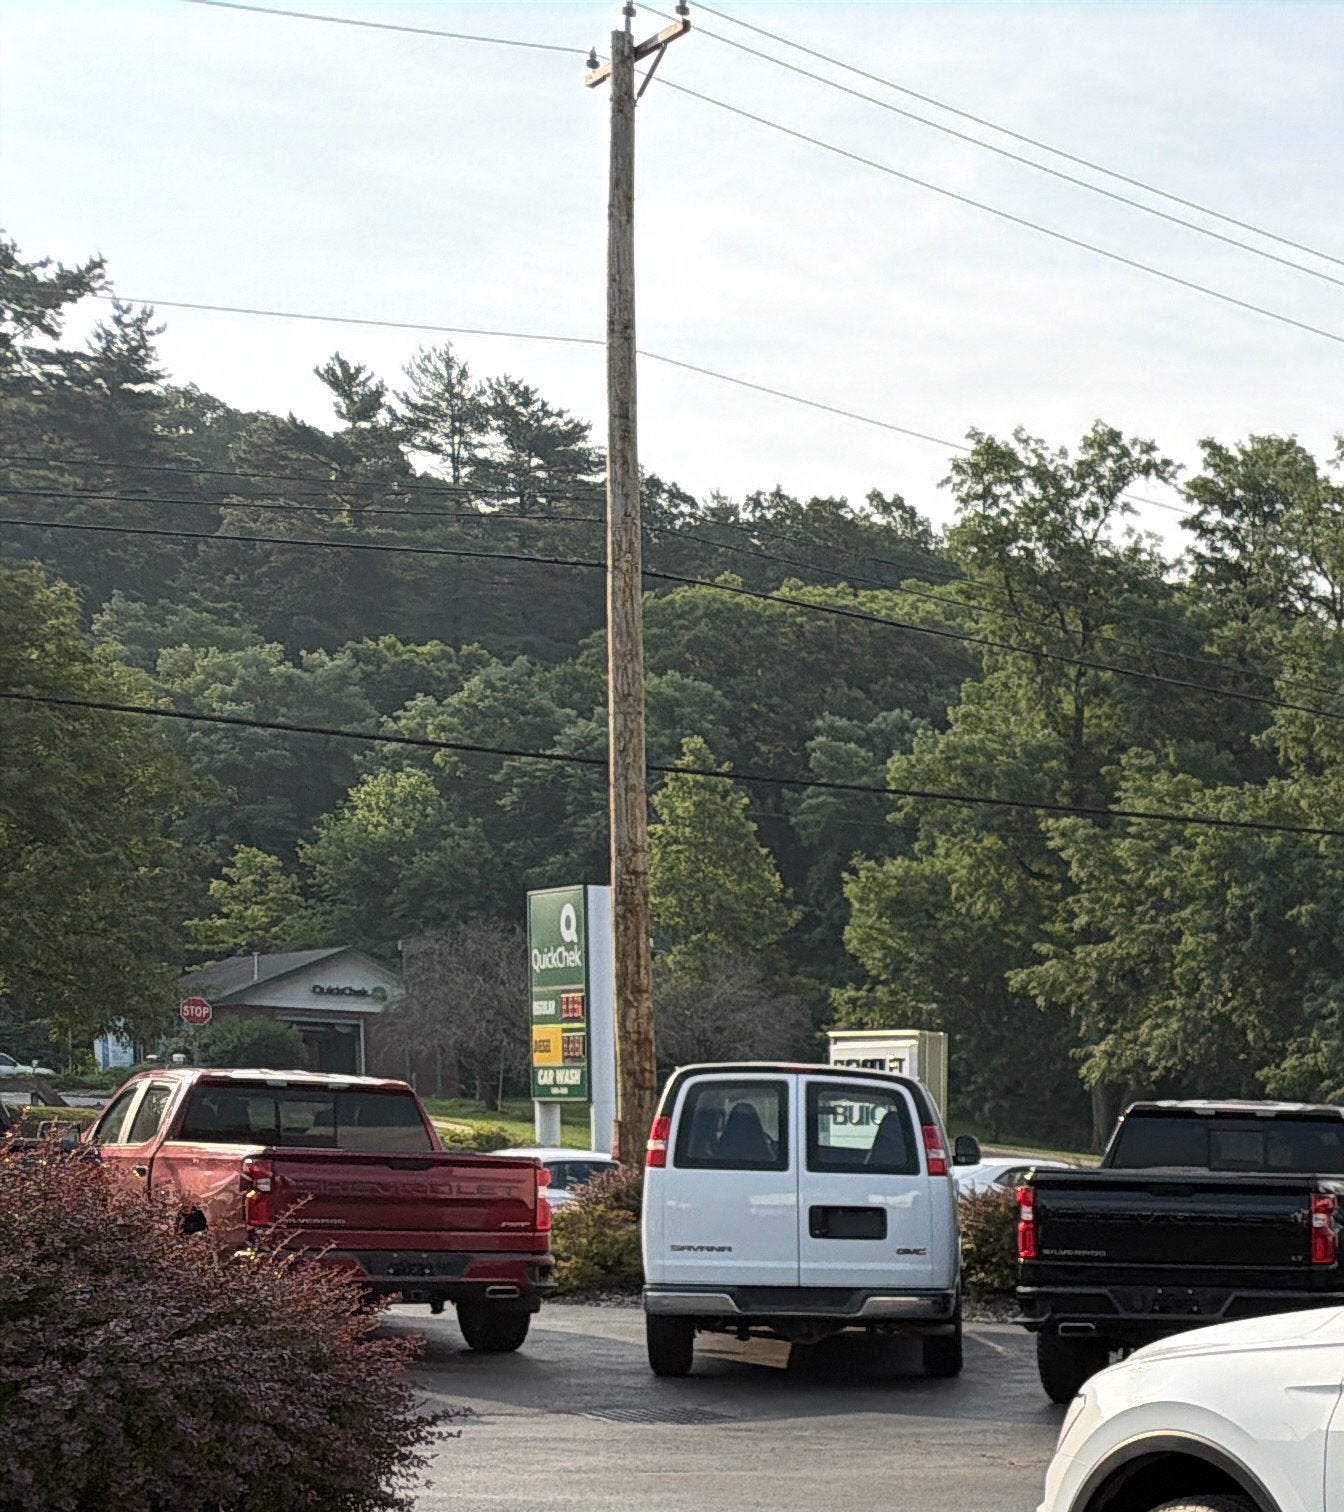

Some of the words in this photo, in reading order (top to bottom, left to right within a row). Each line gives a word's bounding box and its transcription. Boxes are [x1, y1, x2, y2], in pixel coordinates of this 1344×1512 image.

[560, 903, 578, 943] Q
[532, 945, 582, 973] QuickChek
[183, 1005, 210, 1017] STOP
[537, 1068, 555, 1085] CAR
[556, 1068, 581, 1085] WASH
[833, 1104, 888, 1126] BUIC
[281, 1217, 347, 1225] ILVERADO
[670, 1244, 733, 1253] SAVANA
[896, 1247, 927, 1256] GMC
[1042, 1248, 1107, 1257] SILVERADO
